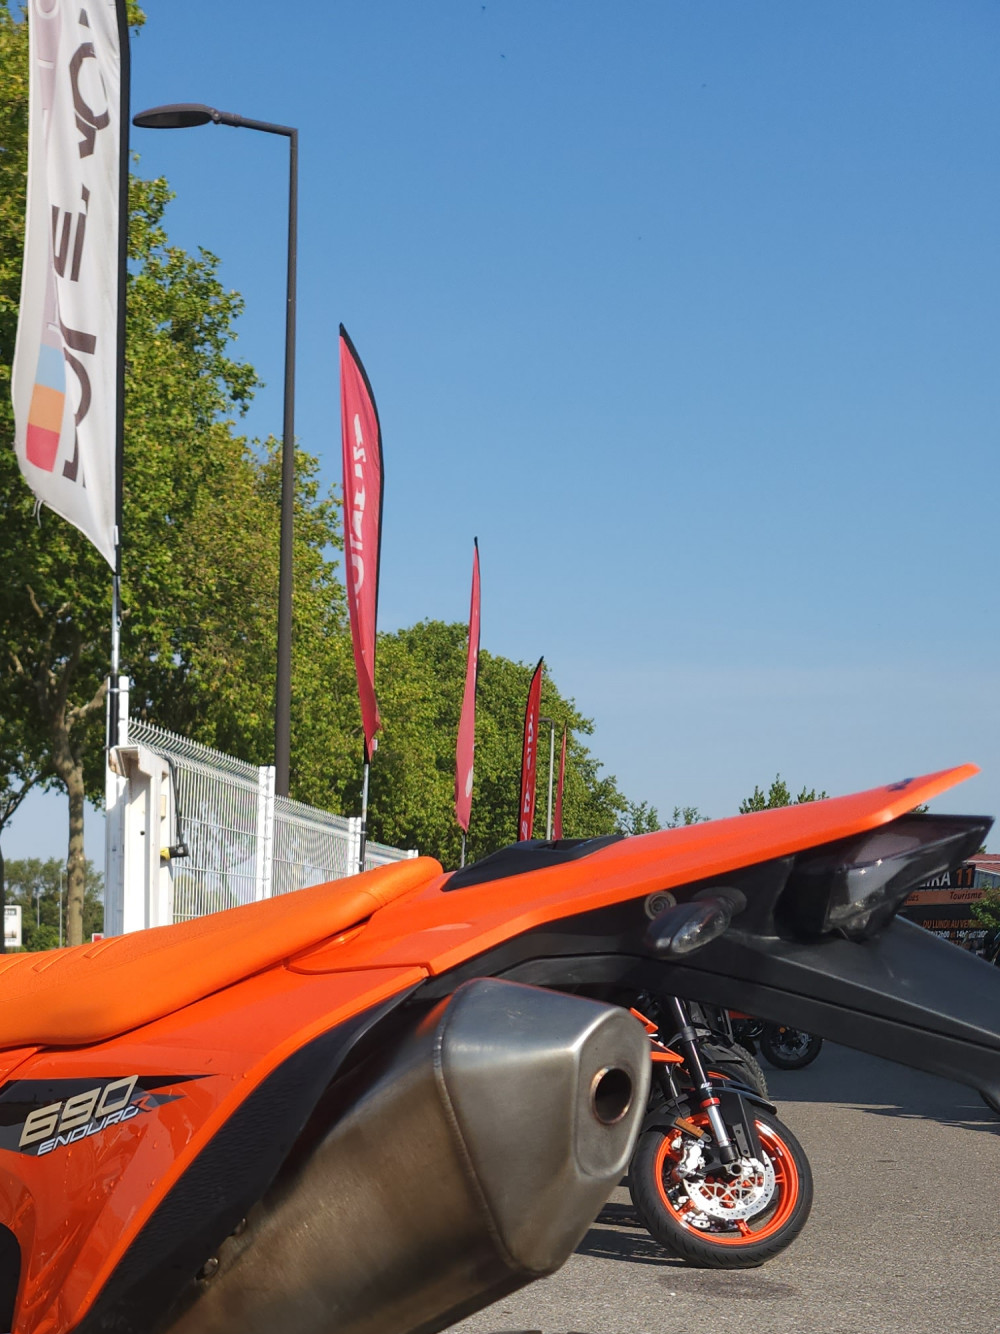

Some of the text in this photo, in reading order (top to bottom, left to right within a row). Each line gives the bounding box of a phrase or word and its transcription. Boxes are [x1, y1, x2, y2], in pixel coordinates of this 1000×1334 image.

[957, 867, 973, 886] 11
[950, 890, 982, 900] Tourisme
[932, 919, 950, 929] LUNDI
[950, 919, 959, 928] AU
[19, 1074, 139, 1147] 690
[37, 1105, 139, 1156] ENDURO
